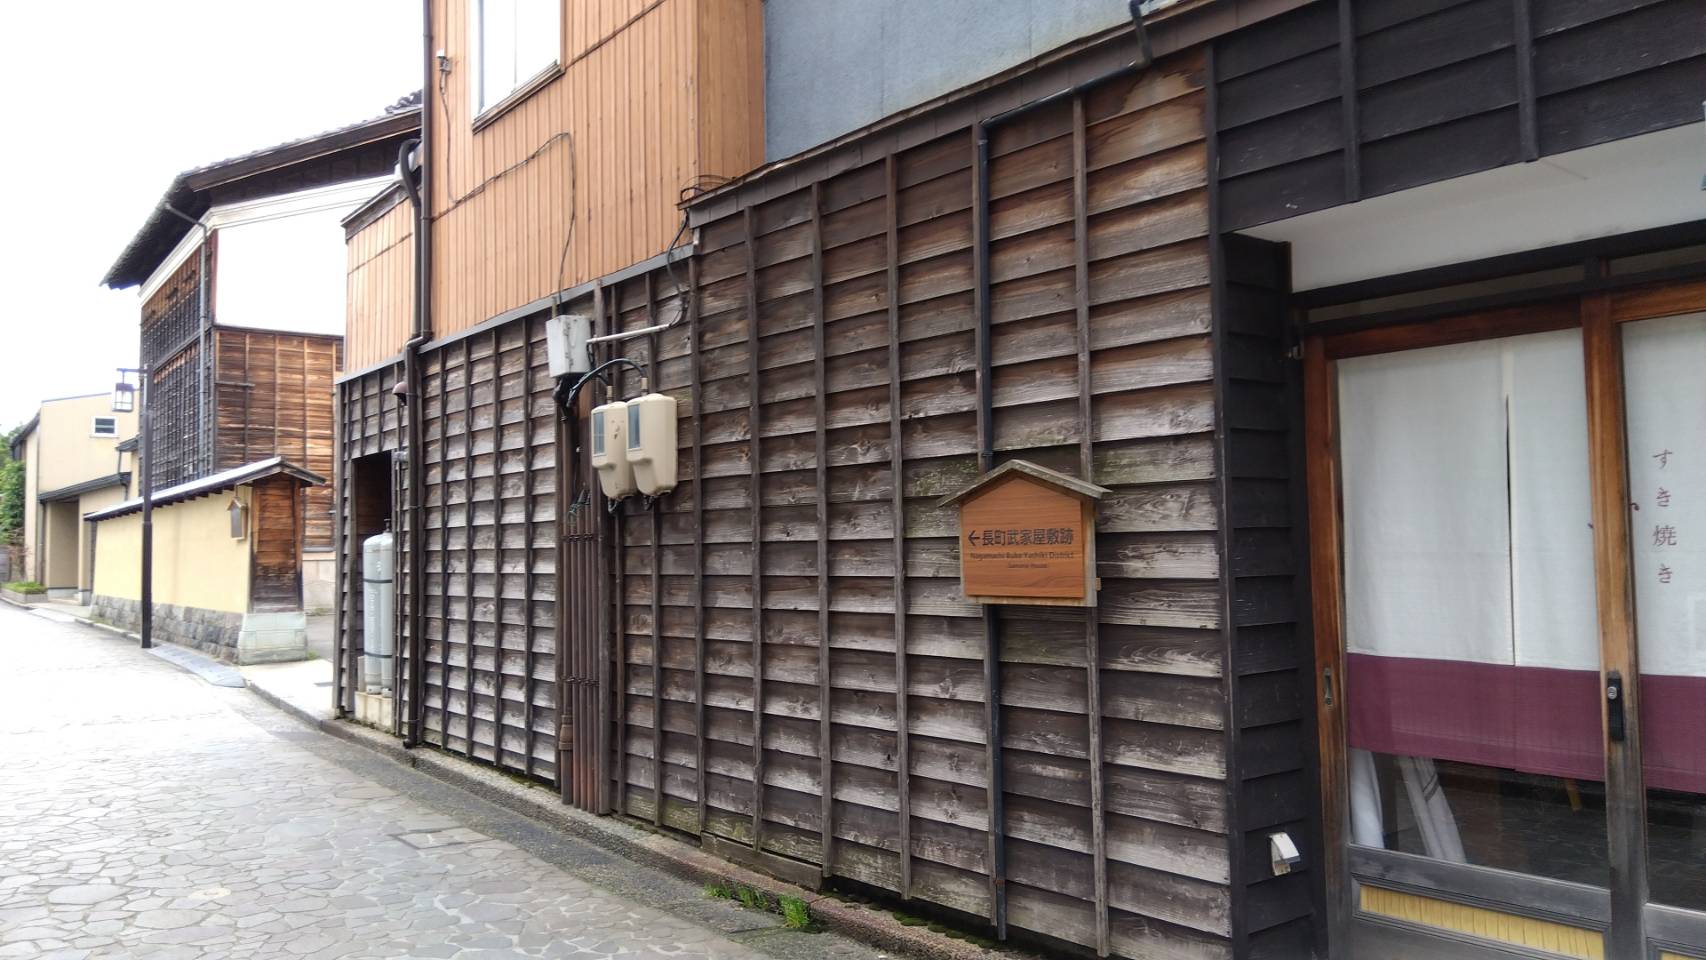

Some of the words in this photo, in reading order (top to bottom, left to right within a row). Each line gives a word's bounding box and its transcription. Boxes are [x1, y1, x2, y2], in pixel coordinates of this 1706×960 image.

[982, 528, 1073, 546] 長町武家屋敷跡
[1652, 449, 1677, 584] すき焼き
